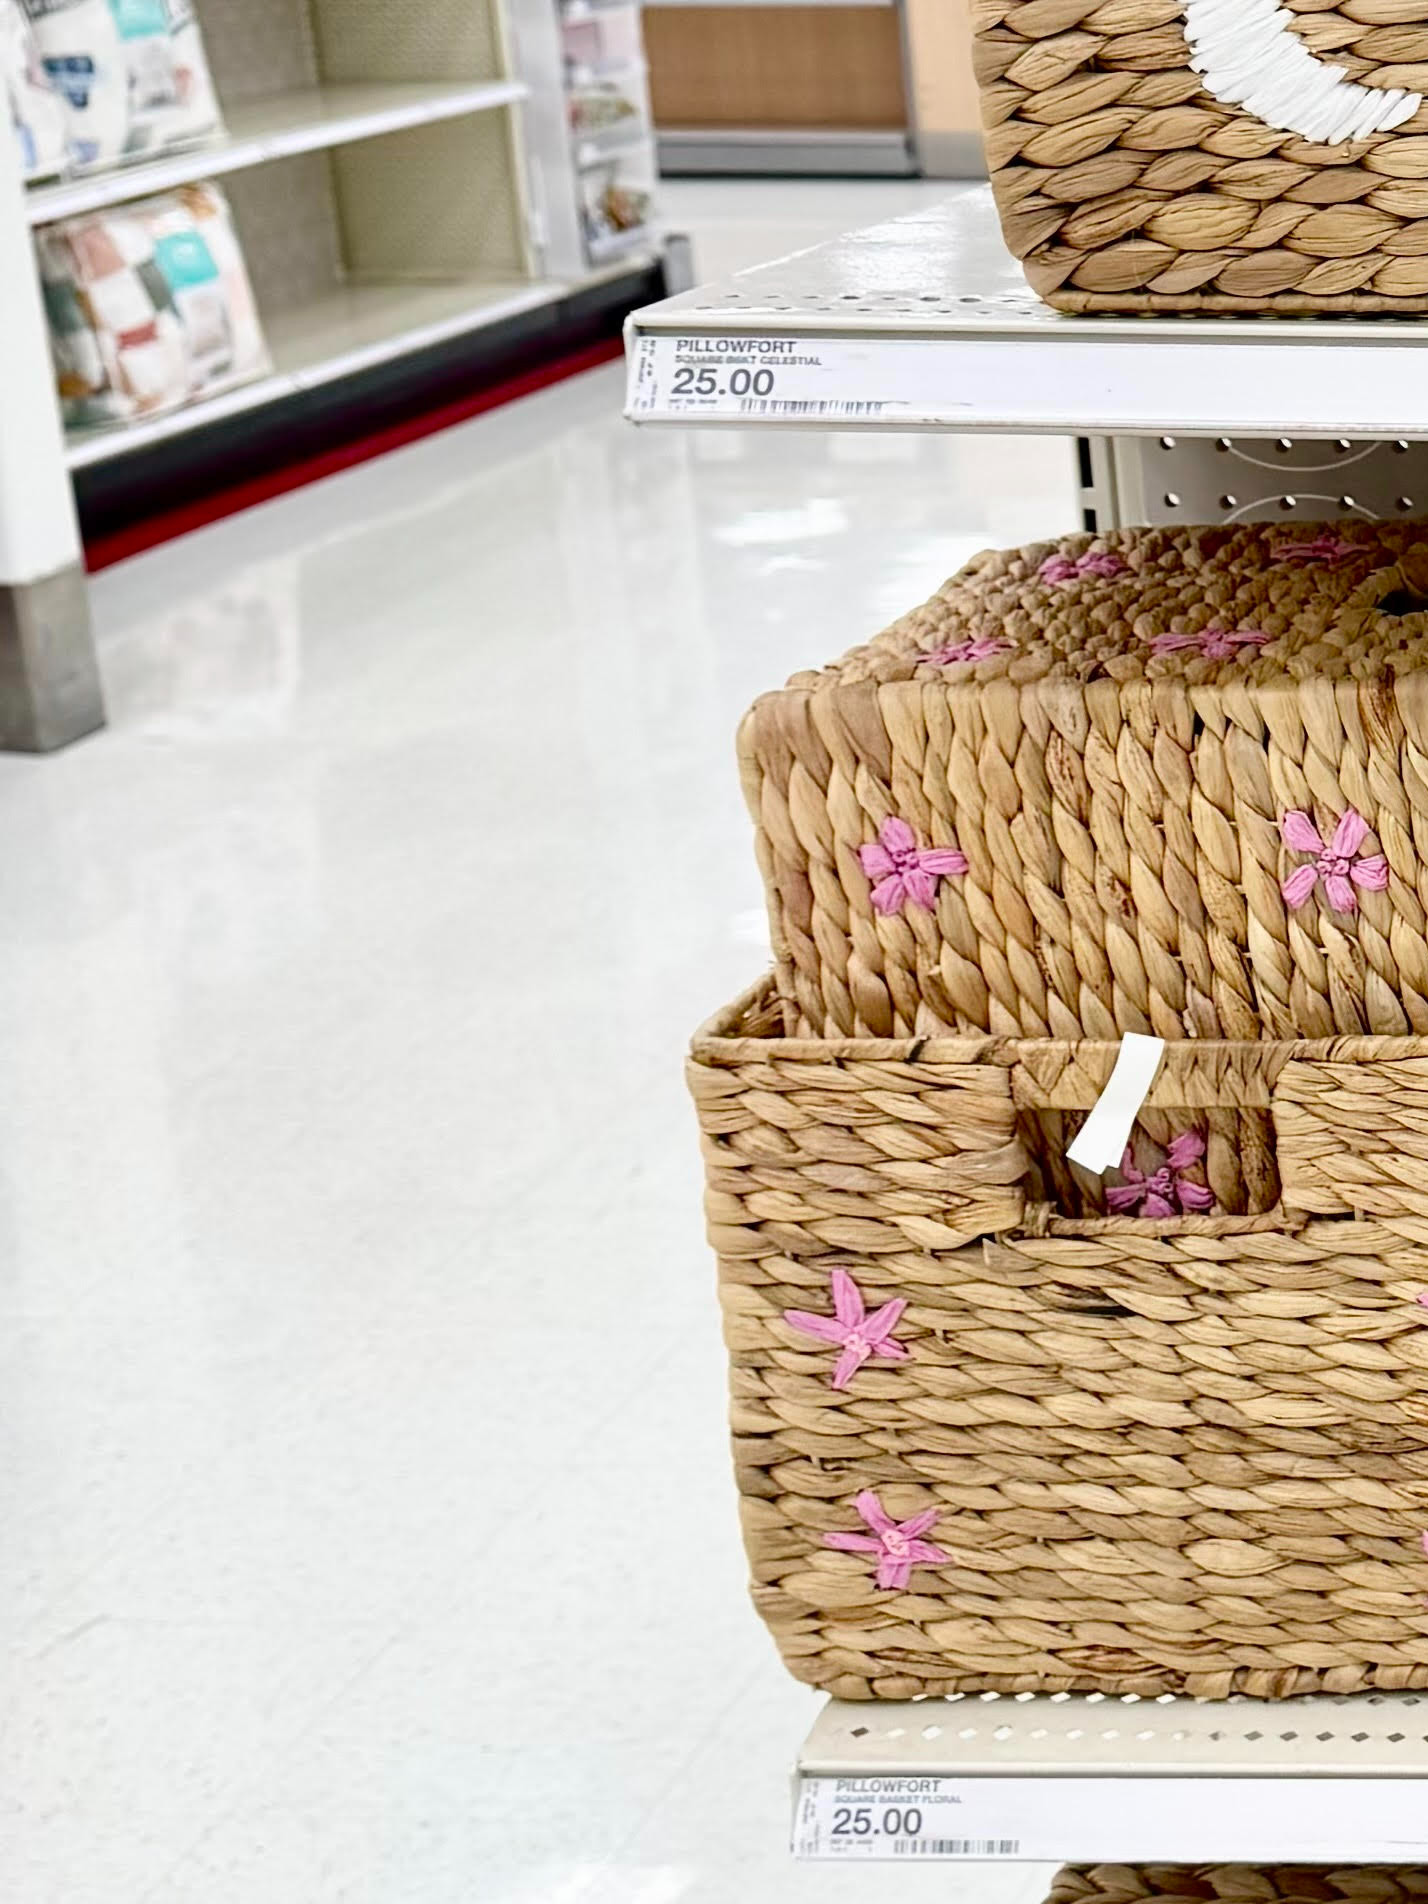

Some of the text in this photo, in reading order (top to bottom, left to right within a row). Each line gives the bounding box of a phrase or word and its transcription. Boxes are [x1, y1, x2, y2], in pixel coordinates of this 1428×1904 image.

[676, 340, 797, 353] PILLOWFORT
[675, 355, 723, 364] SQUARE
[760, 356, 822, 366] CELESTIAL
[671, 368, 774, 396] 25.00
[836, 1779, 942, 1793] PILLOWFORT
[834, 1795, 962, 1804] SQUARE BASKET FLORAL
[832, 1808, 922, 1836] 25.00
